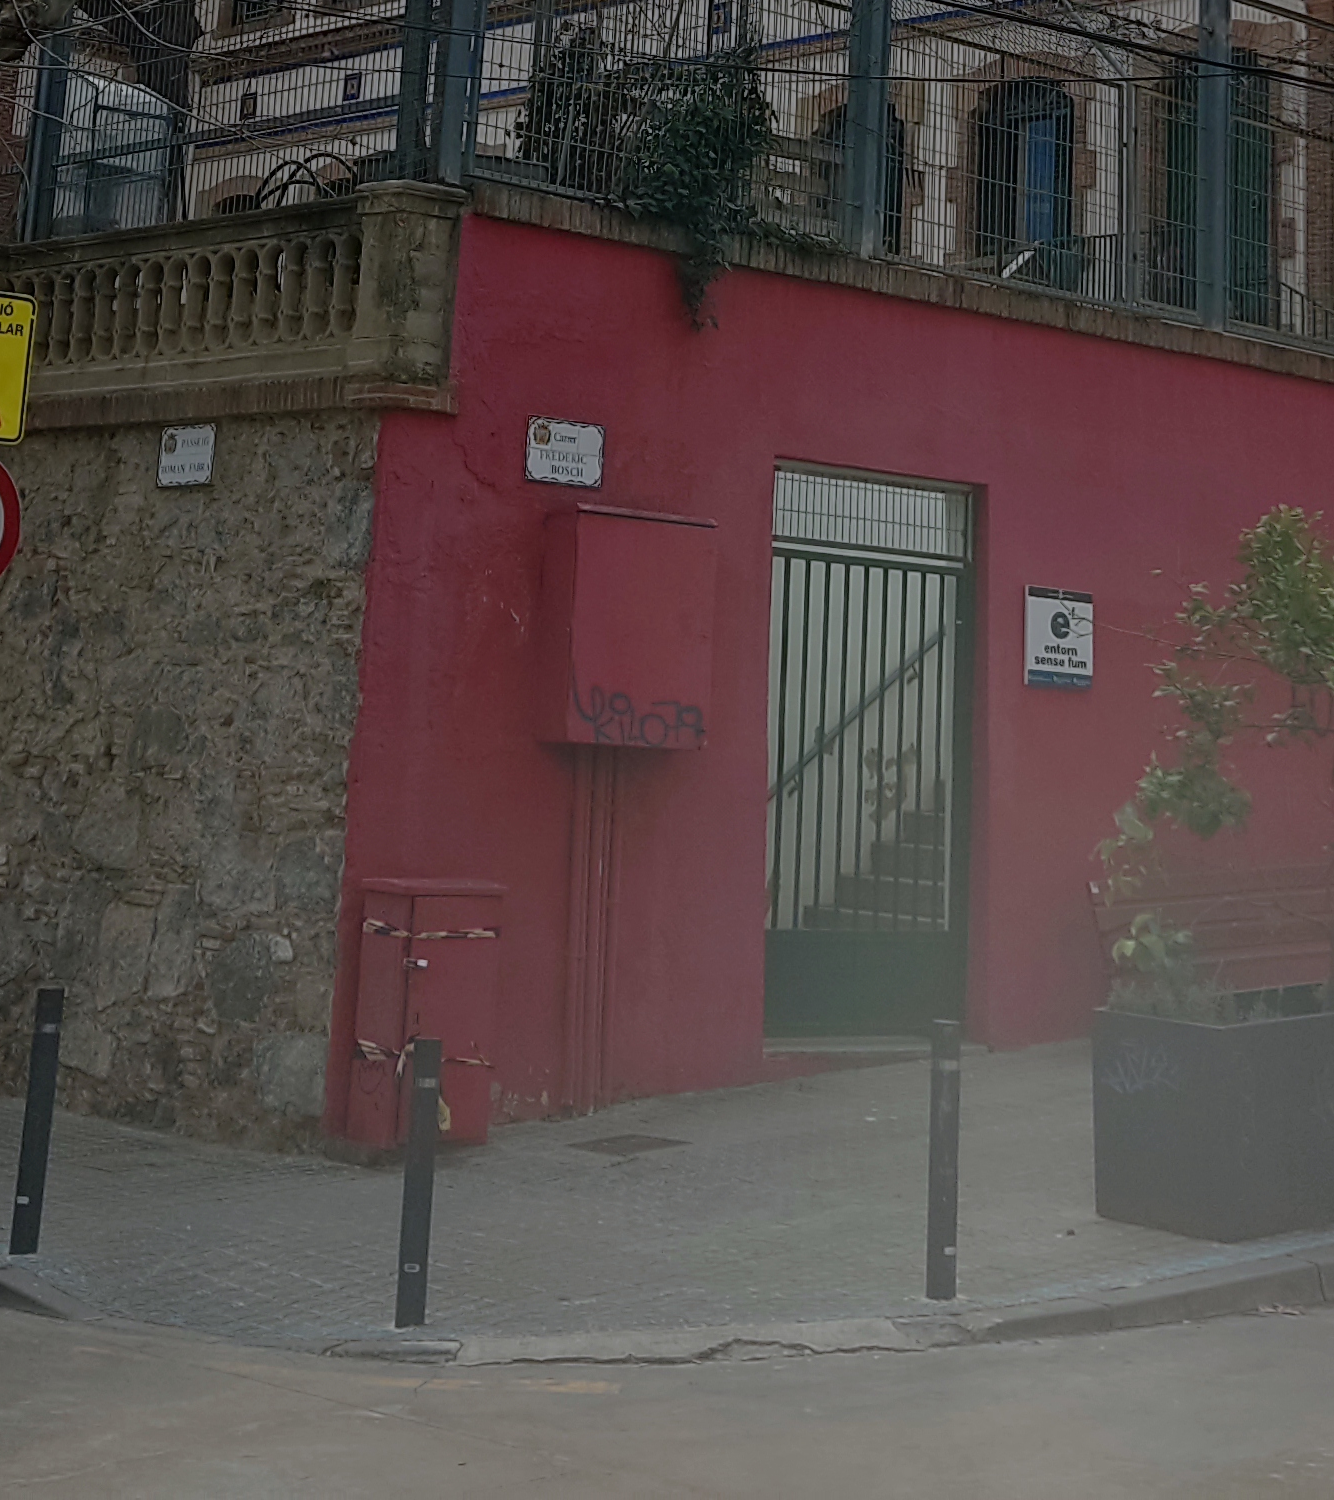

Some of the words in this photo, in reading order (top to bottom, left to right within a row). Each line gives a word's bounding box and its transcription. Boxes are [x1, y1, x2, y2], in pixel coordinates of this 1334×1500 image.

[551, 464, 584, 478] BOSCH
[1044, 644, 1078, 657] entorn
[1034, 656, 1065, 667] sense
[1068, 656, 1088, 669] fum
